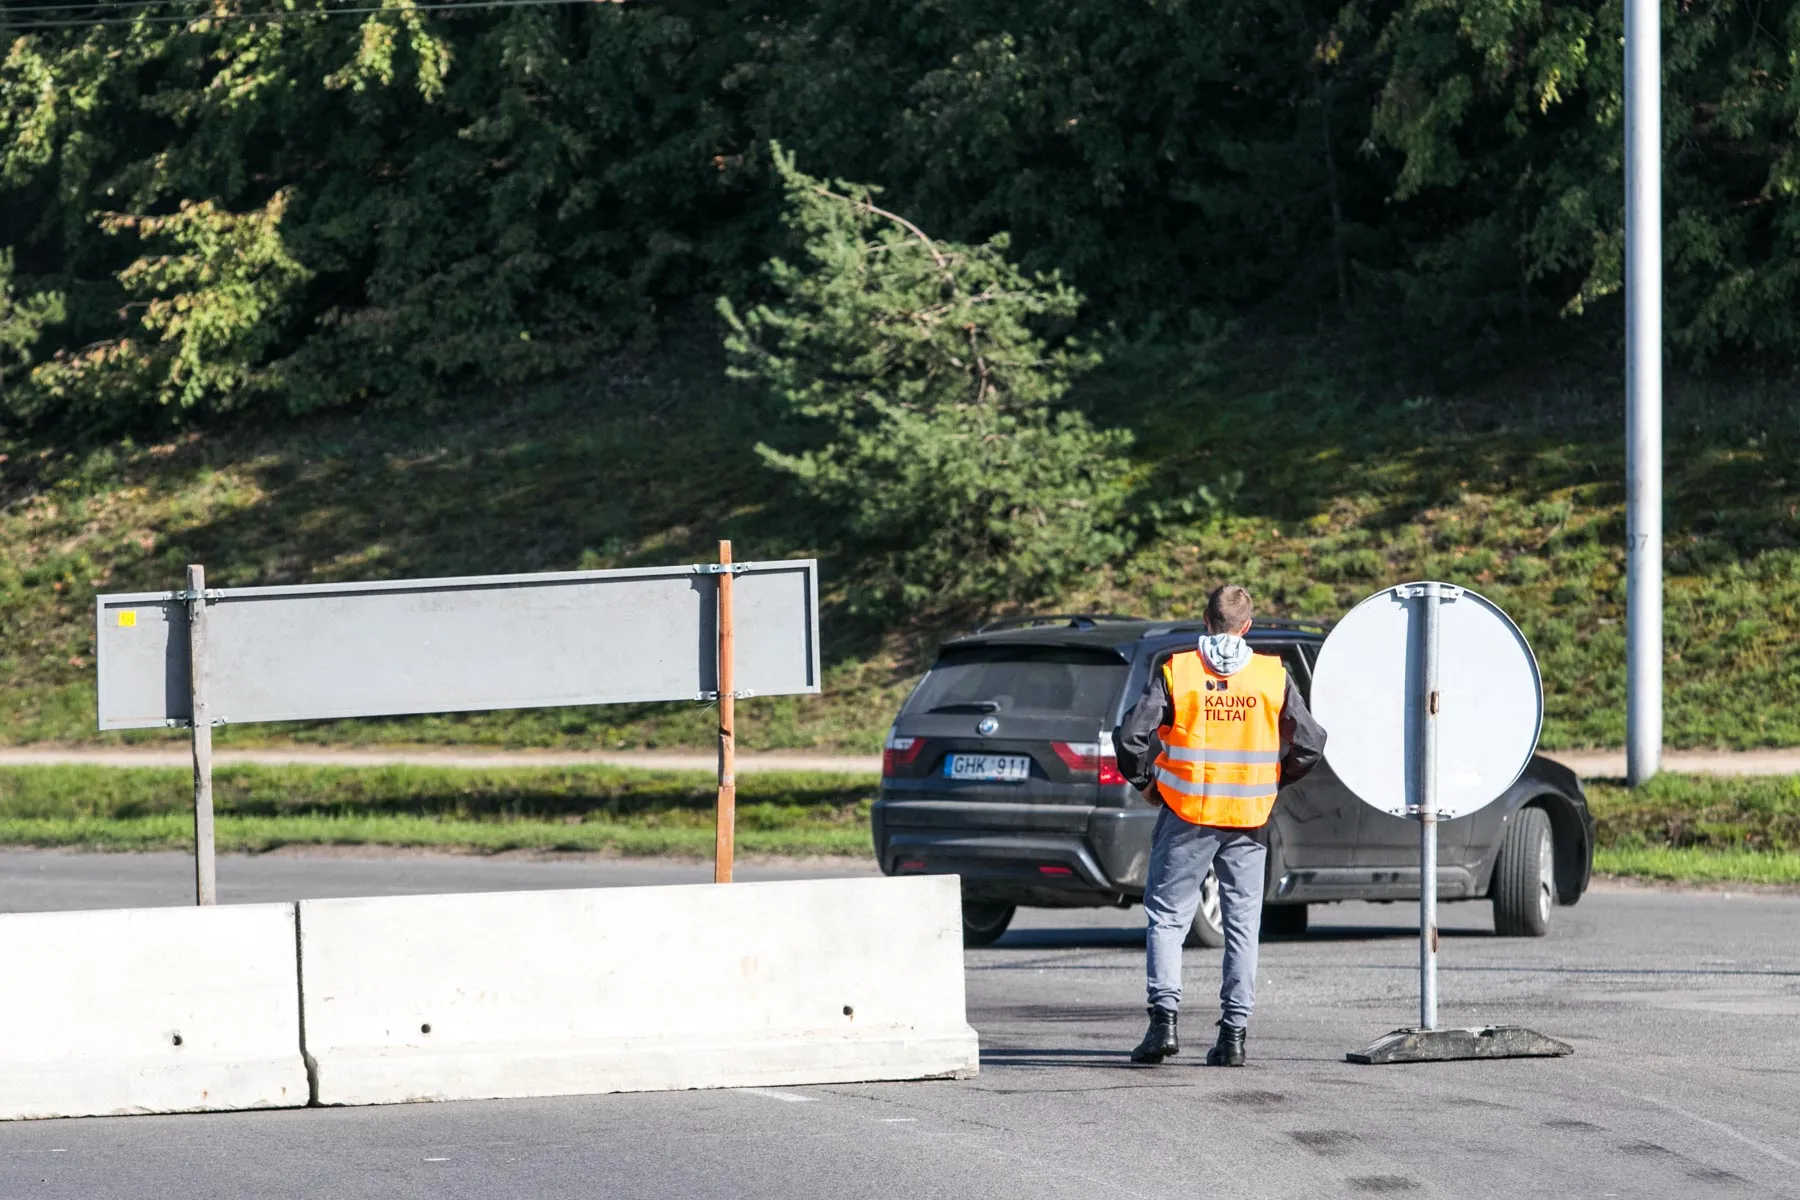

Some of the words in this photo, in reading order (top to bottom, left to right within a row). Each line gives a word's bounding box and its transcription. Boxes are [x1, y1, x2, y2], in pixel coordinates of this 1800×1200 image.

[1204, 695, 1257, 708] KAUNO
[1204, 709, 1246, 721] TILTAI
[955, 757, 987, 773] GHK
[996, 758, 1025, 775] 911
